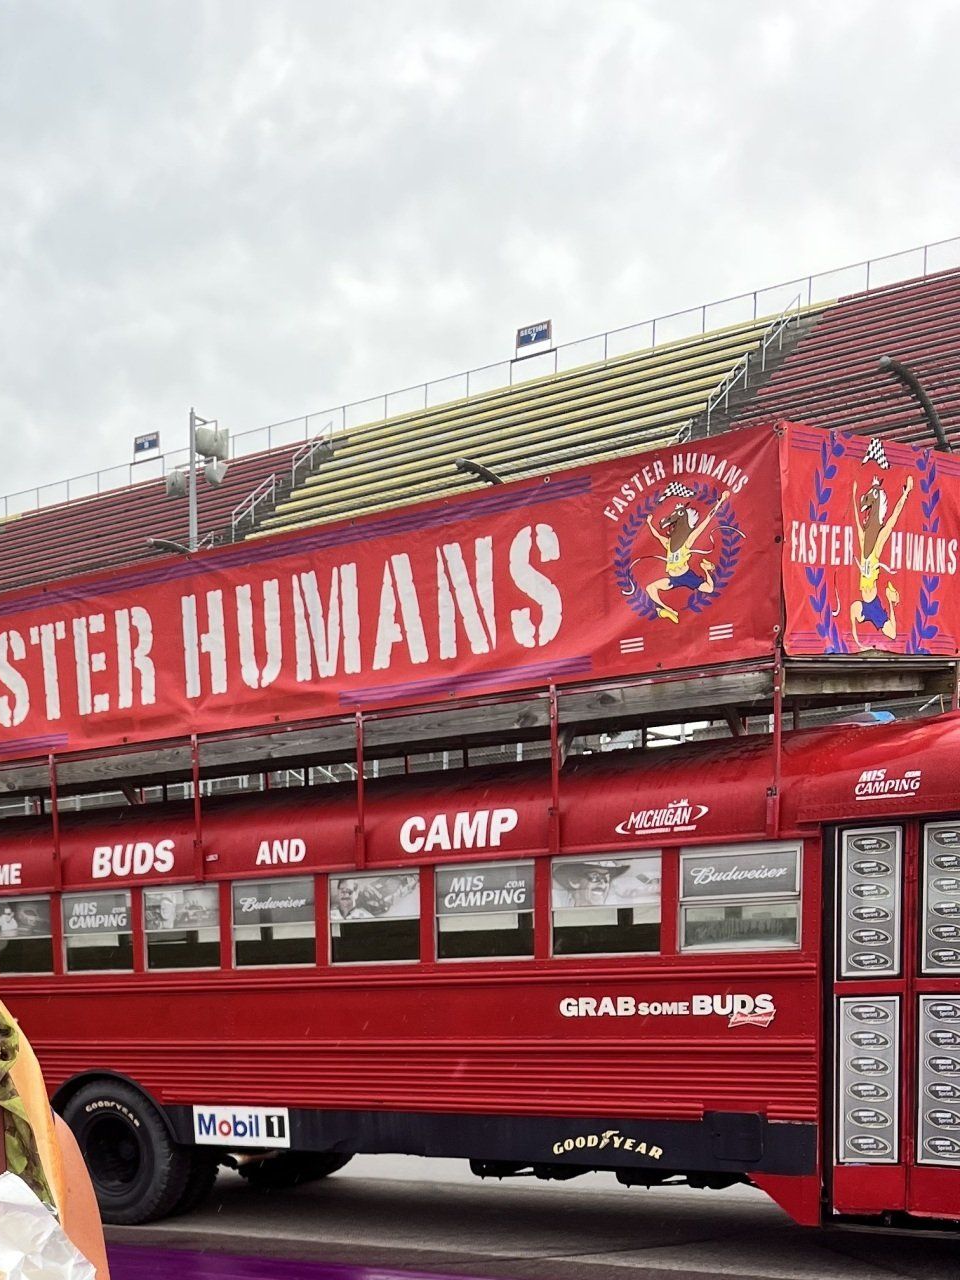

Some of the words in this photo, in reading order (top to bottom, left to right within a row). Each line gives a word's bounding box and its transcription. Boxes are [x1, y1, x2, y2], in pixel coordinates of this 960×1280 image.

[604, 460, 666, 521] FASTER
[672, 453, 749, 493] HUMANS
[791, 521, 854, 565] FASTER
[891, 532, 958, 575] HUMANS
[181, 523, 563, 699] HUMANS
[855, 778, 921, 795] CAMPING
[627, 807, 693, 829] MICHIGAN
[92, 839, 175, 879] BUDS
[255, 838, 307, 865] AND
[399, 808, 519, 854] CAMP
[450, 875, 485, 892] MIS
[690, 865, 788, 885] Budweiser
[72, 902, 97, 915] MIS
[240, 897, 306, 912] Budweiser
[444, 888, 526, 908] CAMPING
[68, 914, 127, 929] CAMPING
[559, 996, 636, 1017] GRAB
[638, 1001, 690, 1015] SOME
[692, 994, 775, 1016] BUDS
[197, 1113, 260, 1138] Mobil
[269, 1116, 280, 1138] 1
